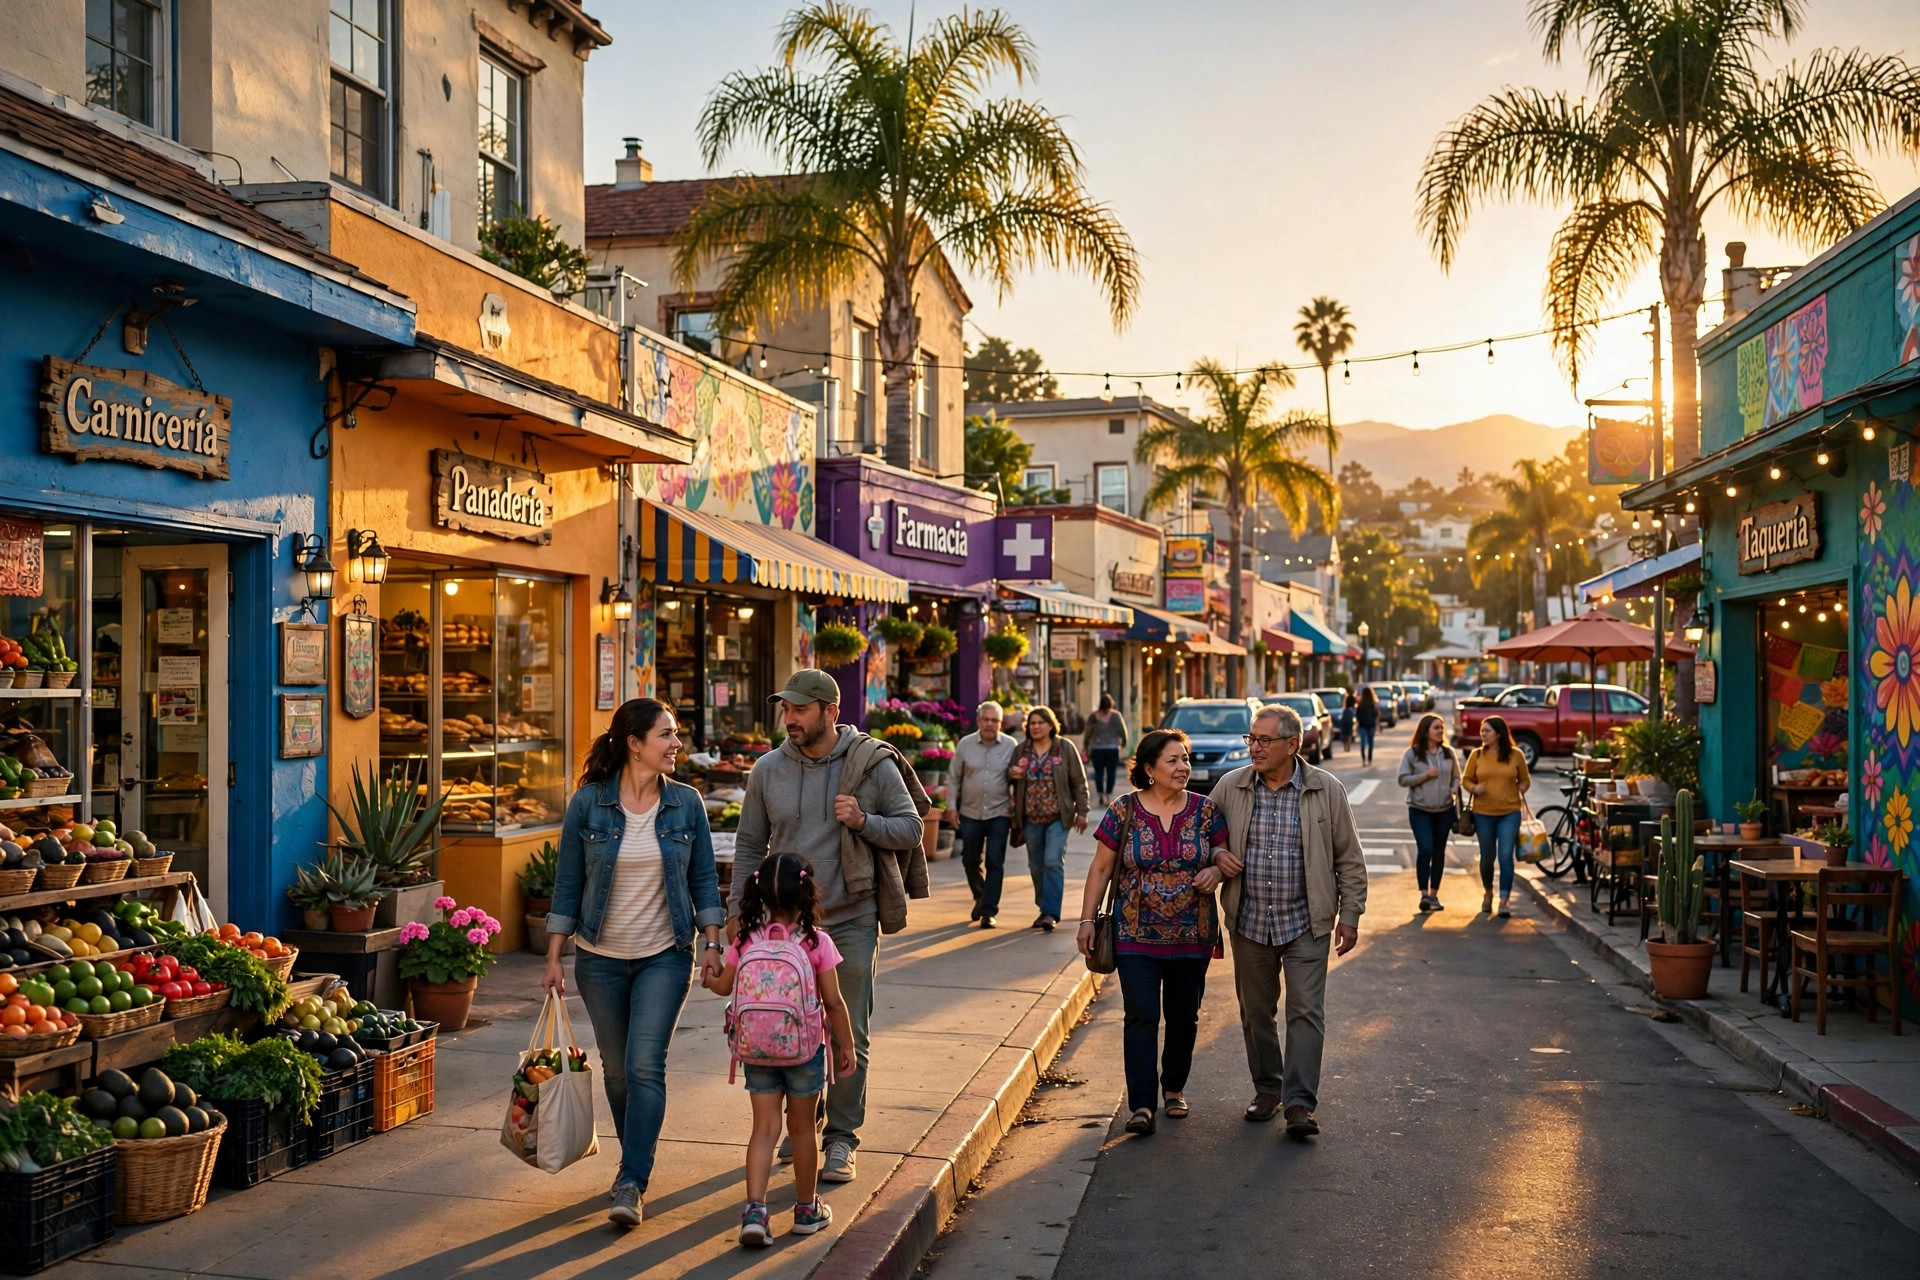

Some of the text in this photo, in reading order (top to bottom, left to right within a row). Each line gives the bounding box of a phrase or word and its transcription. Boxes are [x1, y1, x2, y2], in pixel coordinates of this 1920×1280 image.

[67, 378, 218, 456] Carnicería
[896, 506, 968, 557] Farmacia
[1741, 505, 1809, 571] Taquería
